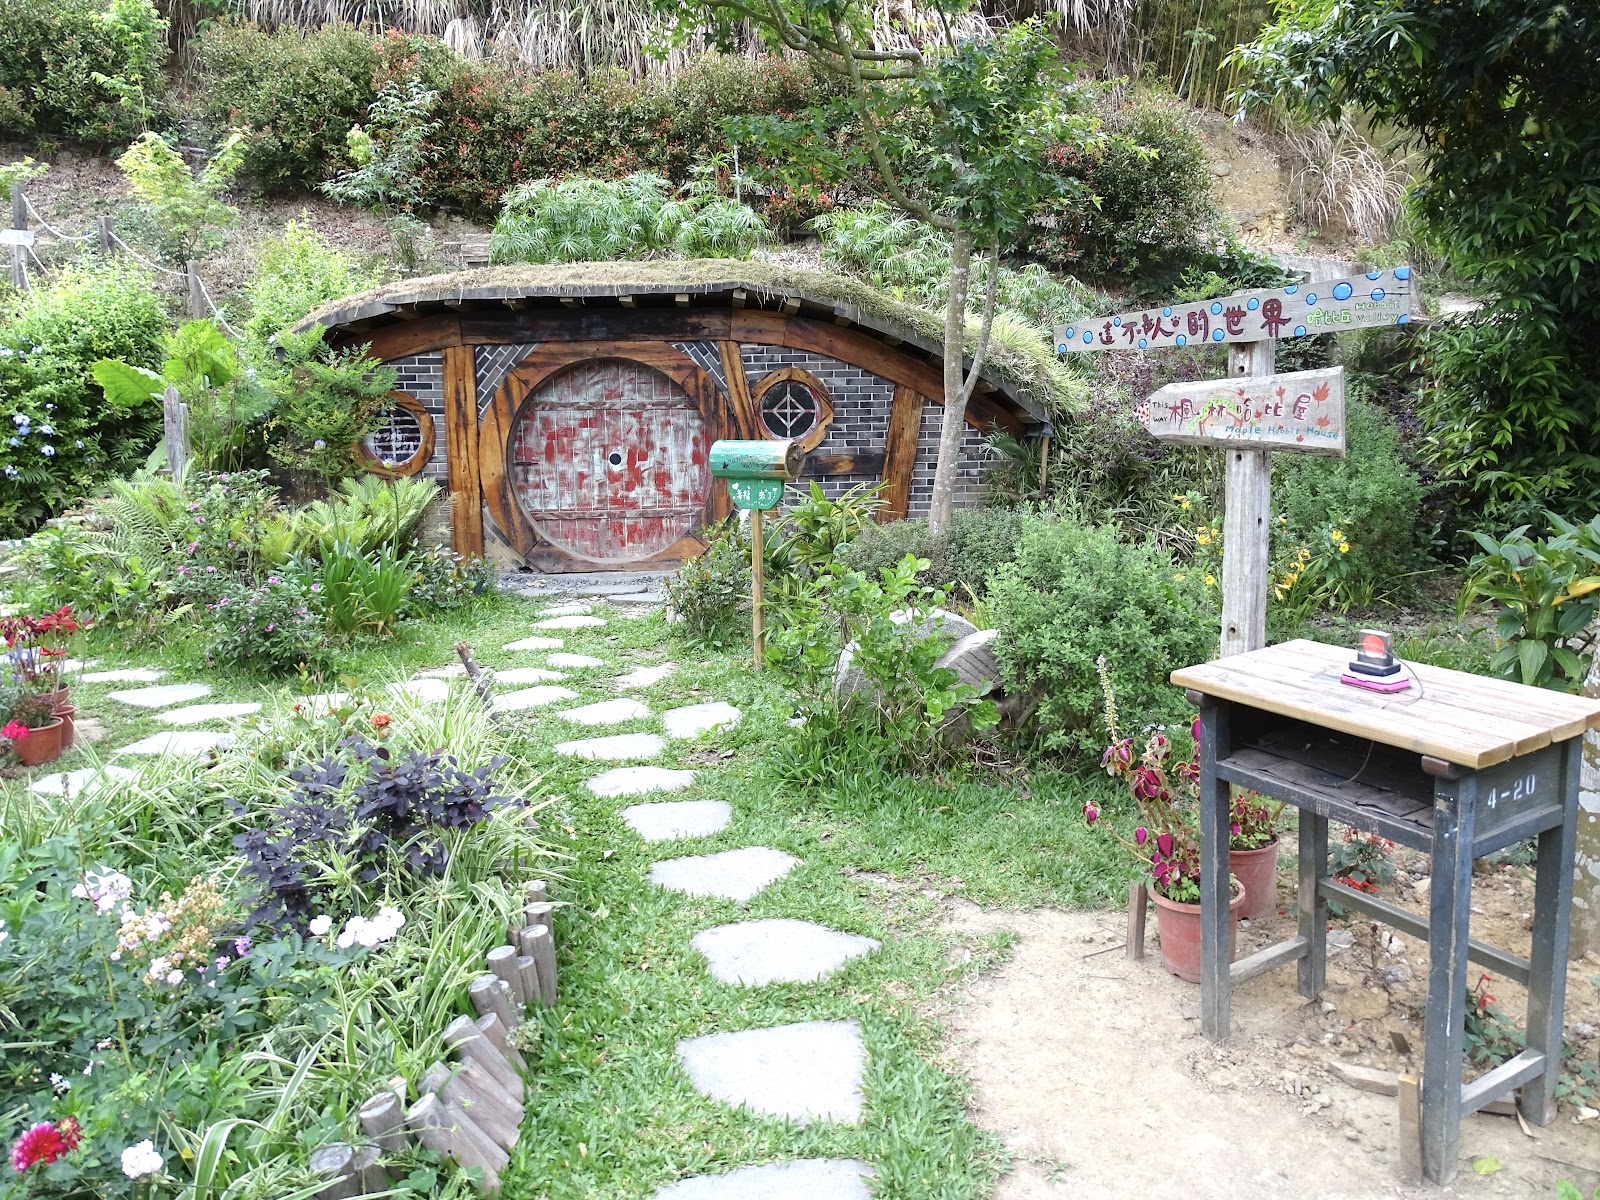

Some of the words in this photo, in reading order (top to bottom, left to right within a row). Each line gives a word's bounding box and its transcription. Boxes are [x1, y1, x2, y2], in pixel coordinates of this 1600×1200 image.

[1168, 392, 1311, 432] 楓林哈比屋
[1225, 425, 1261, 436] Maple
[1307, 426, 1339, 440] House
[1487, 773, 1536, 809] 4-20
